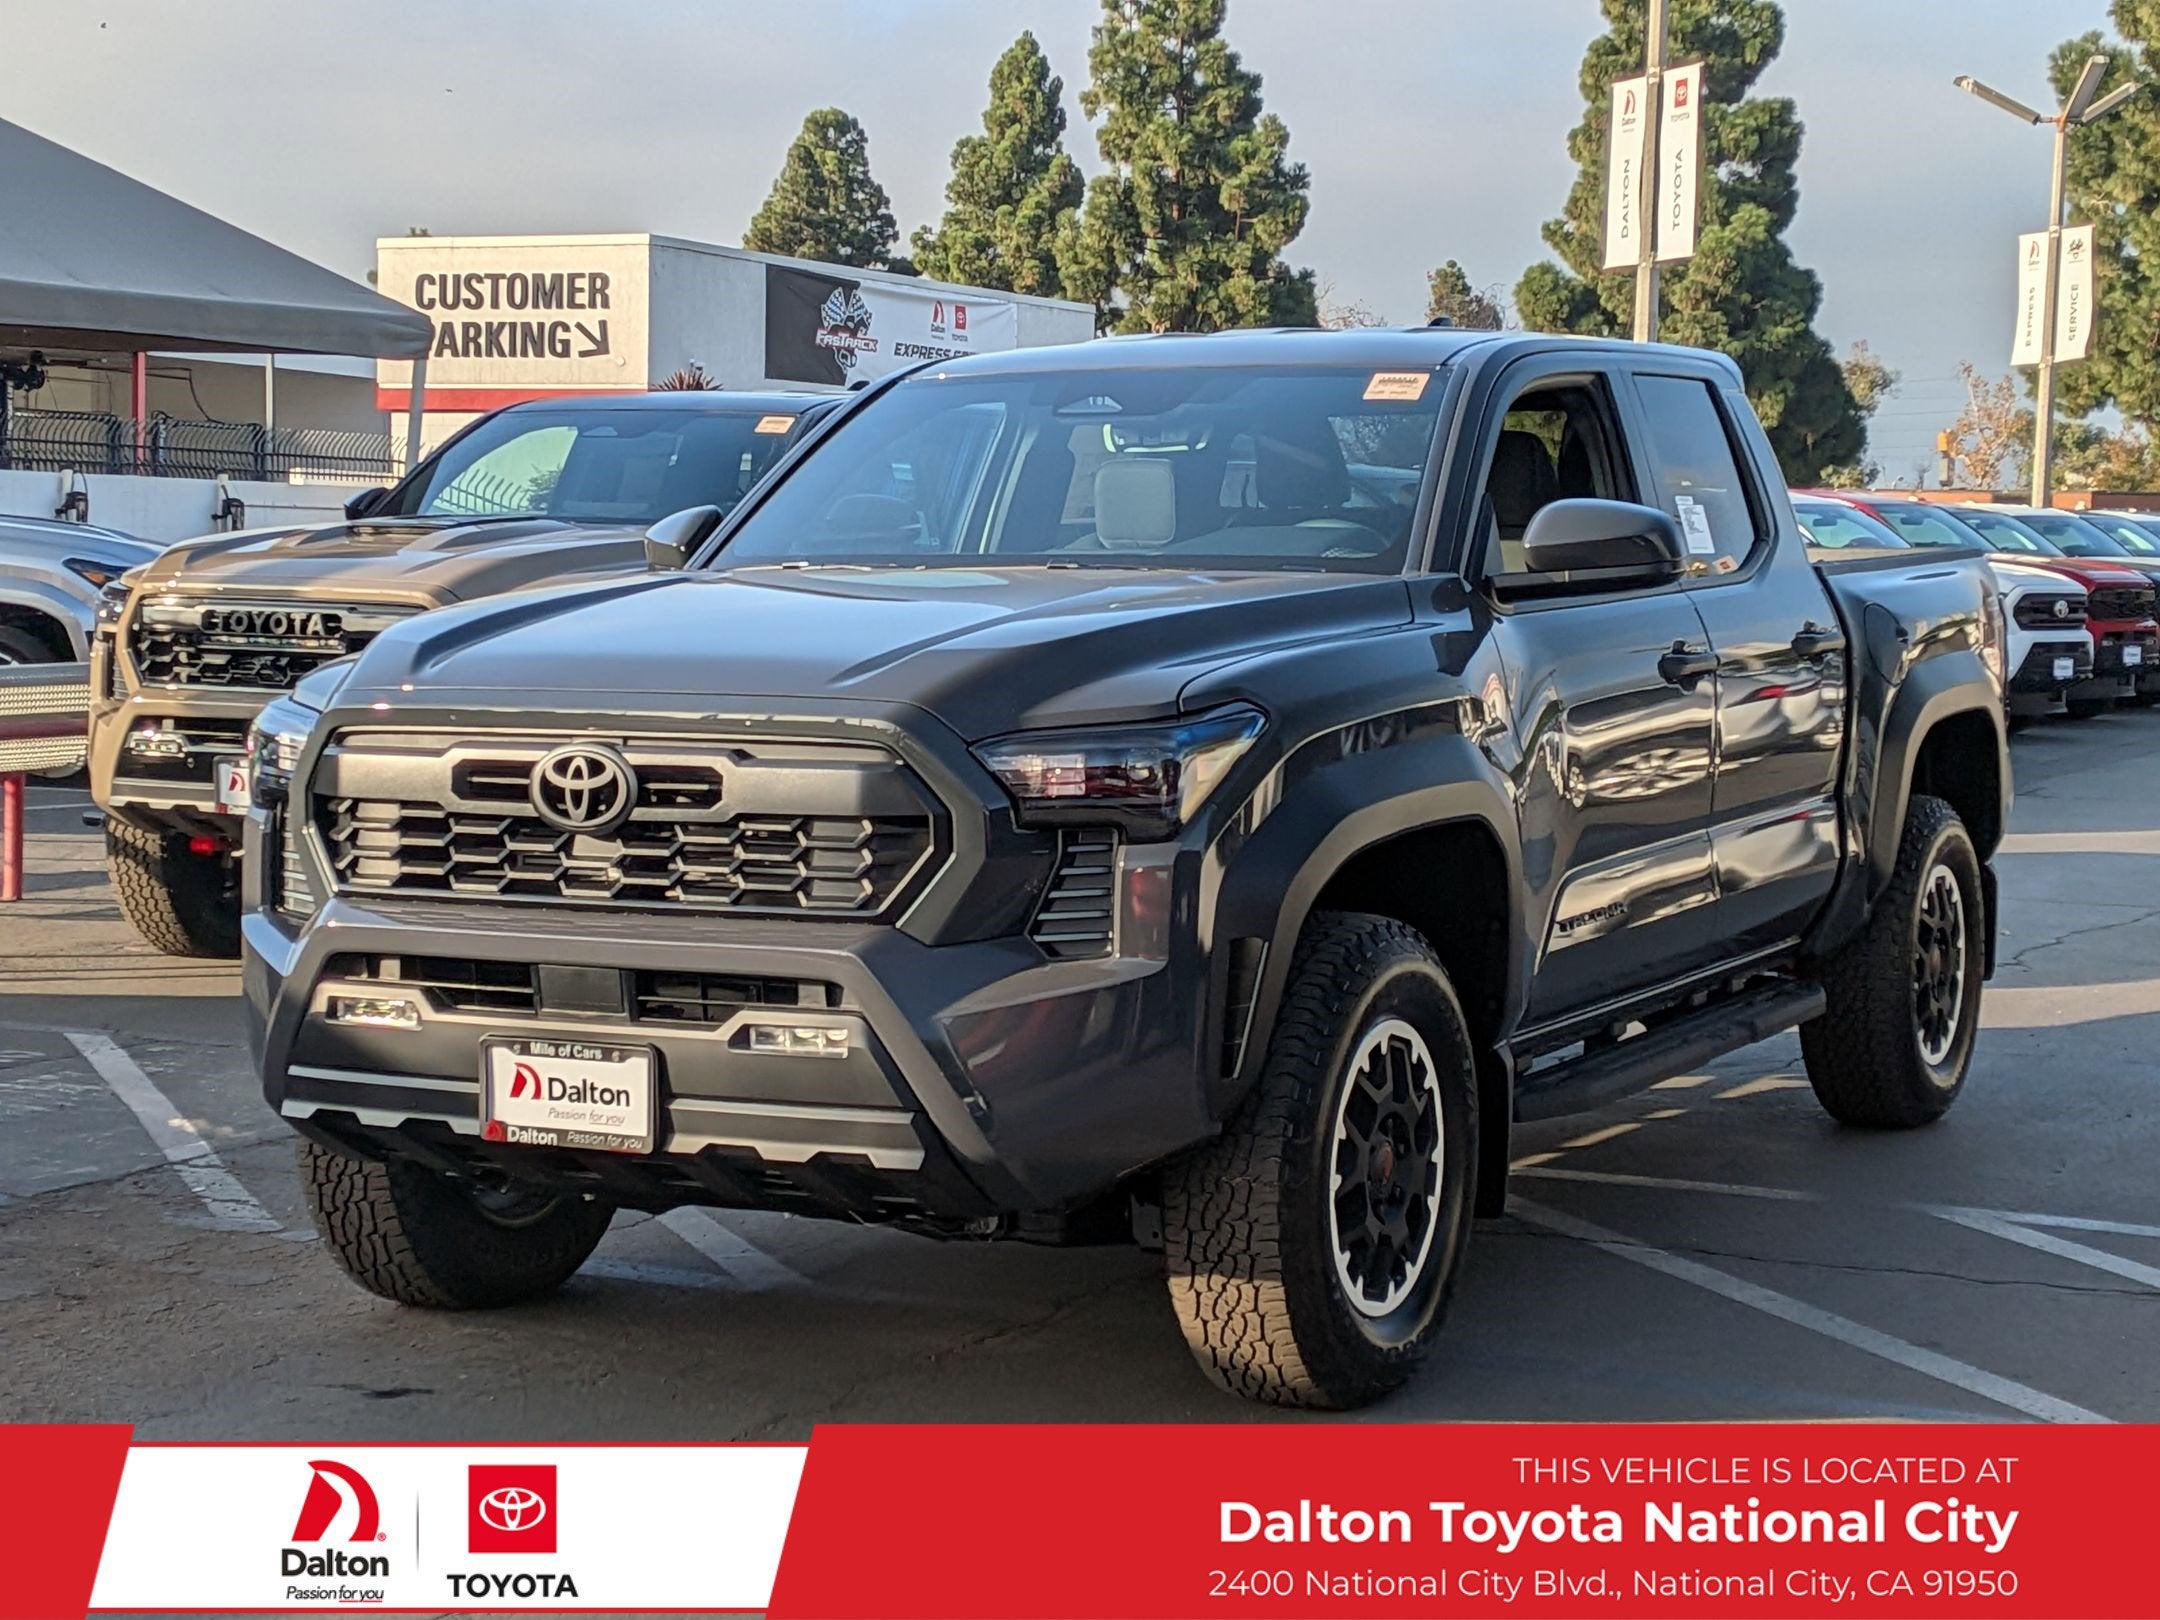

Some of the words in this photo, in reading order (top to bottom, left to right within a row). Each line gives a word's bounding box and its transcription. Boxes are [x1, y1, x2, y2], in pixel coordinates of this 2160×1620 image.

[1620, 158, 1631, 239] DALTON
[1671, 148, 1684, 231] TOYOTA
[415, 272, 611, 310] CUSTOMER
[2068, 284, 2079, 341] SERVICE
[430, 320, 572, 358] ARKING
[894, 342, 951, 359] EXPRESS
[214, 610, 327, 637] TOYOTA
[530, 1042, 556, 1057] Mile
[558, 1044, 572, 1058] of
[573, 1046, 603, 1060] Cars
[547, 1077, 631, 1107] Dalton
[548, 1107, 587, 1121] Passion
[588, 1110, 604, 1124] for
[604, 1114, 626, 1125] you
[507, 1126, 558, 1146] Dalton
[566, 1131, 604, 1145] Passion
[605, 1134, 622, 1147] for
[622, 1136, 643, 1149] you
